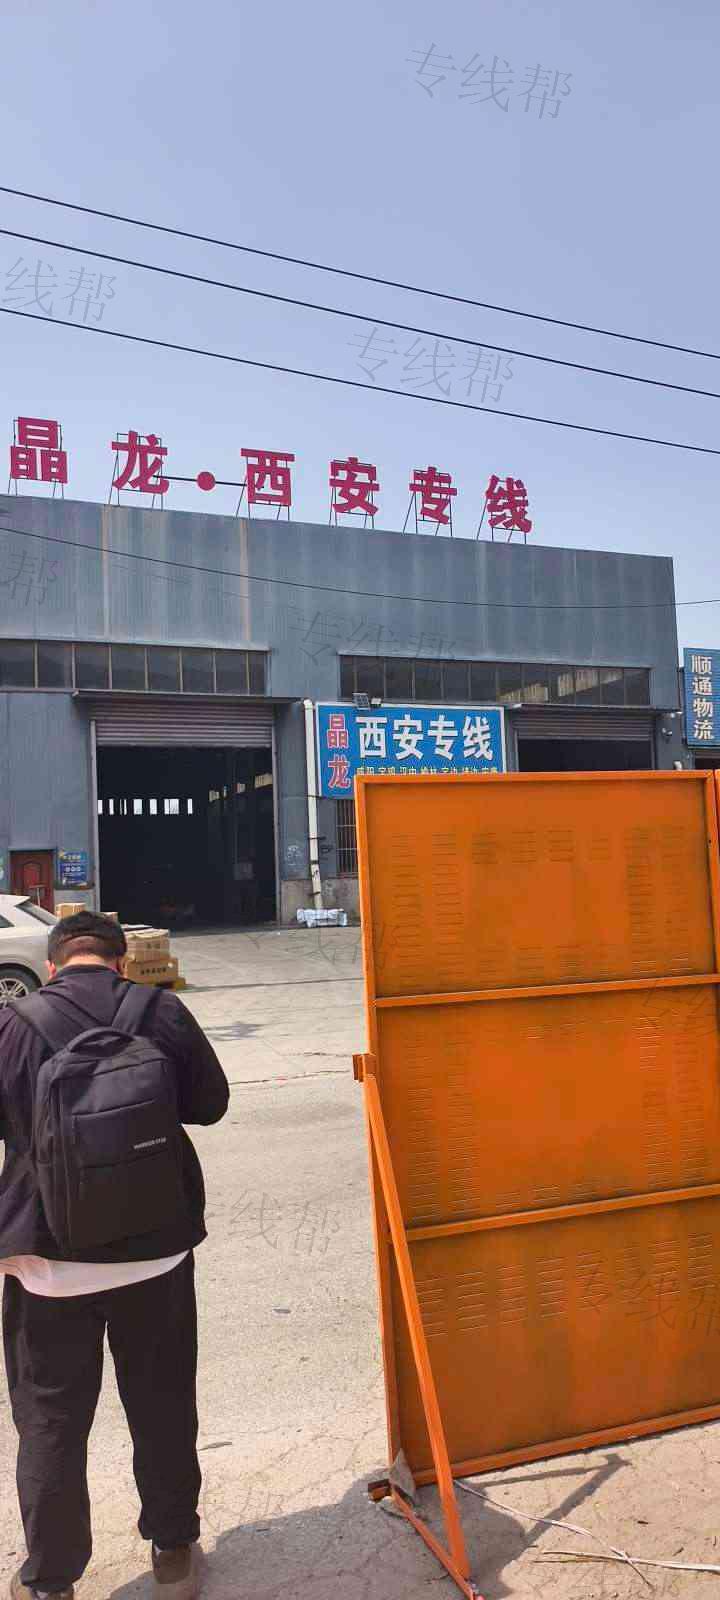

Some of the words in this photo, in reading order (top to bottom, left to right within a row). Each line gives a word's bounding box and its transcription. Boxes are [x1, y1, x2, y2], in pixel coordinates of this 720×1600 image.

[691, 655, 714, 740] 顺通物流
[327, 714, 350, 789] 晶龙
[356, 714, 493, 761] 西安专线
